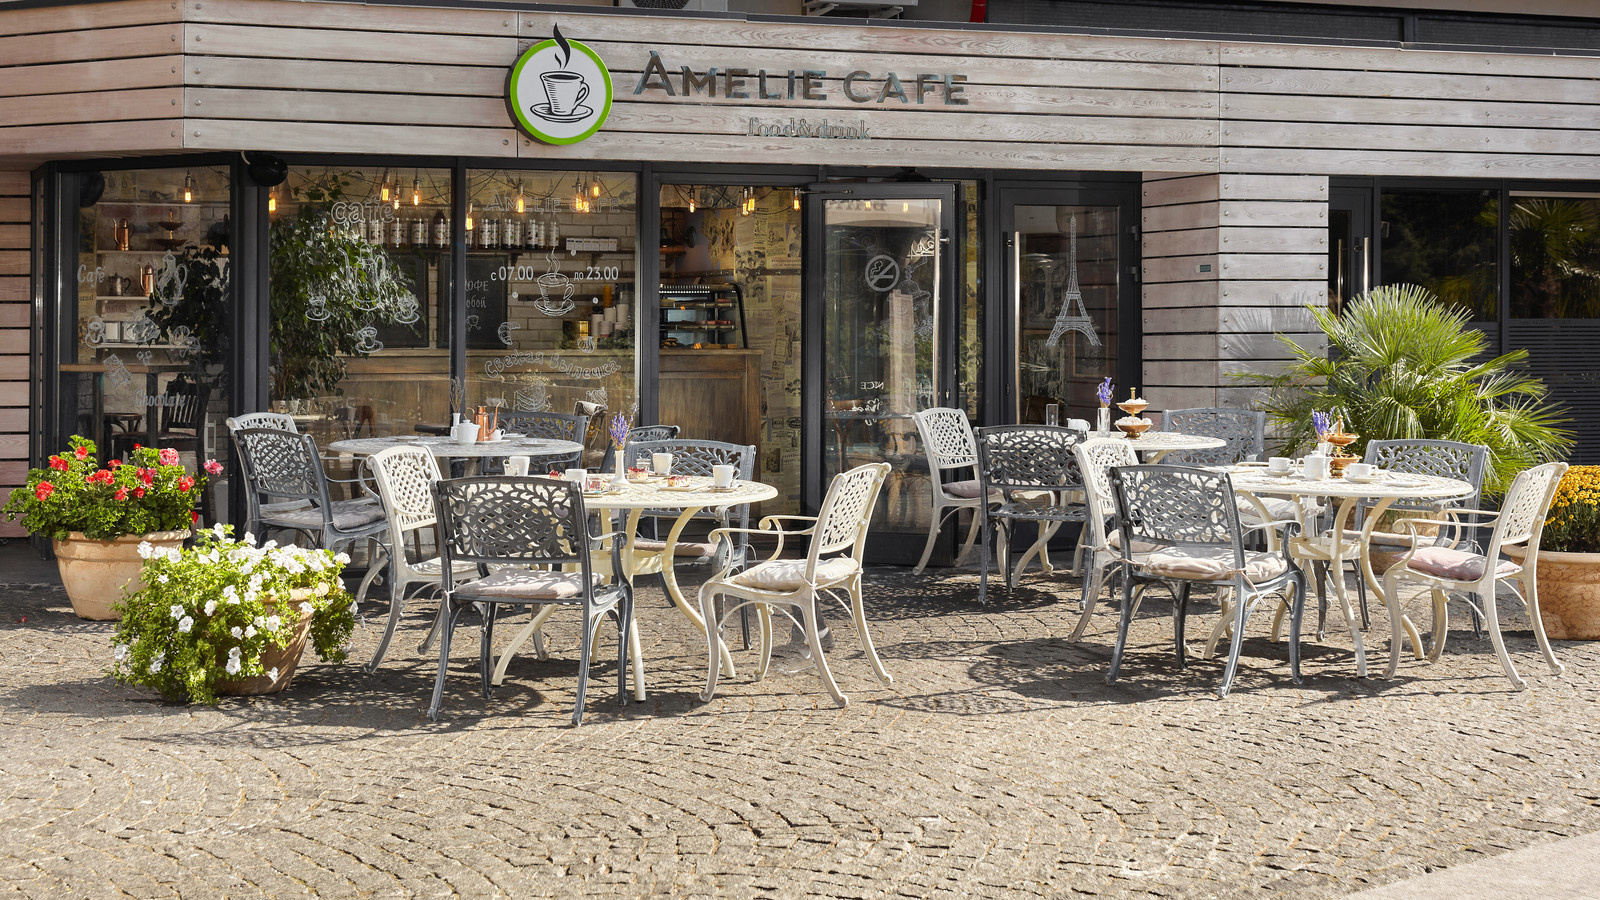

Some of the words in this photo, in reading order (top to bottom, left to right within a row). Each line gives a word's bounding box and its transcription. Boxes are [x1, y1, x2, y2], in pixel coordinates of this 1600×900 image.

[632, 50, 828, 101] AMELIE
[843, 70, 969, 106] CAFE
[498, 265, 534, 282] 07.00
[586, 266, 619, 281] 23.00
[133, 389, 186, 407] Chocolate
